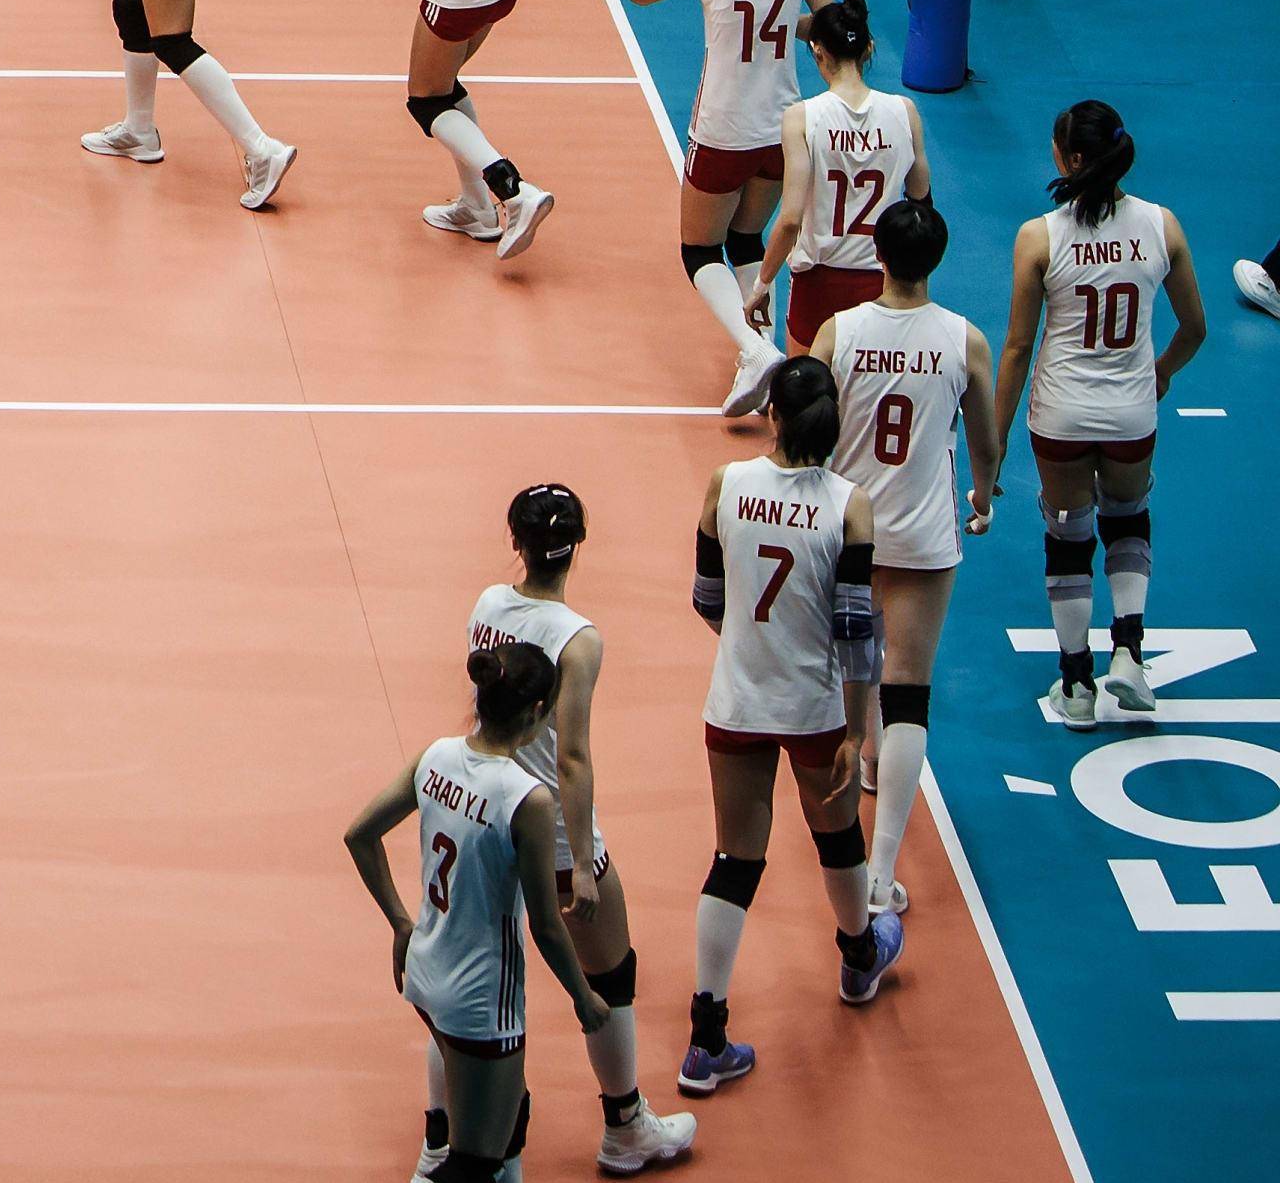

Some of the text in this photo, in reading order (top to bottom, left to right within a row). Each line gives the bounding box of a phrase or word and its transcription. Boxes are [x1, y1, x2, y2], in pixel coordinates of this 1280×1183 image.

[828, 129, 892, 153] YIN X.L.
[827, 170, 885, 237] 12
[1071, 238, 1147, 266] TANG X.
[1074, 281, 1140, 350] 10
[854, 349, 943, 375] ZENG J.Y.
[874, 394, 913, 466] 8
[738, 495, 819, 531] WAN Z.Y.
[754, 544, 794, 623] 7
[422, 768, 493, 830] ZHAO Y.L.
[428, 831, 458, 914] 3
